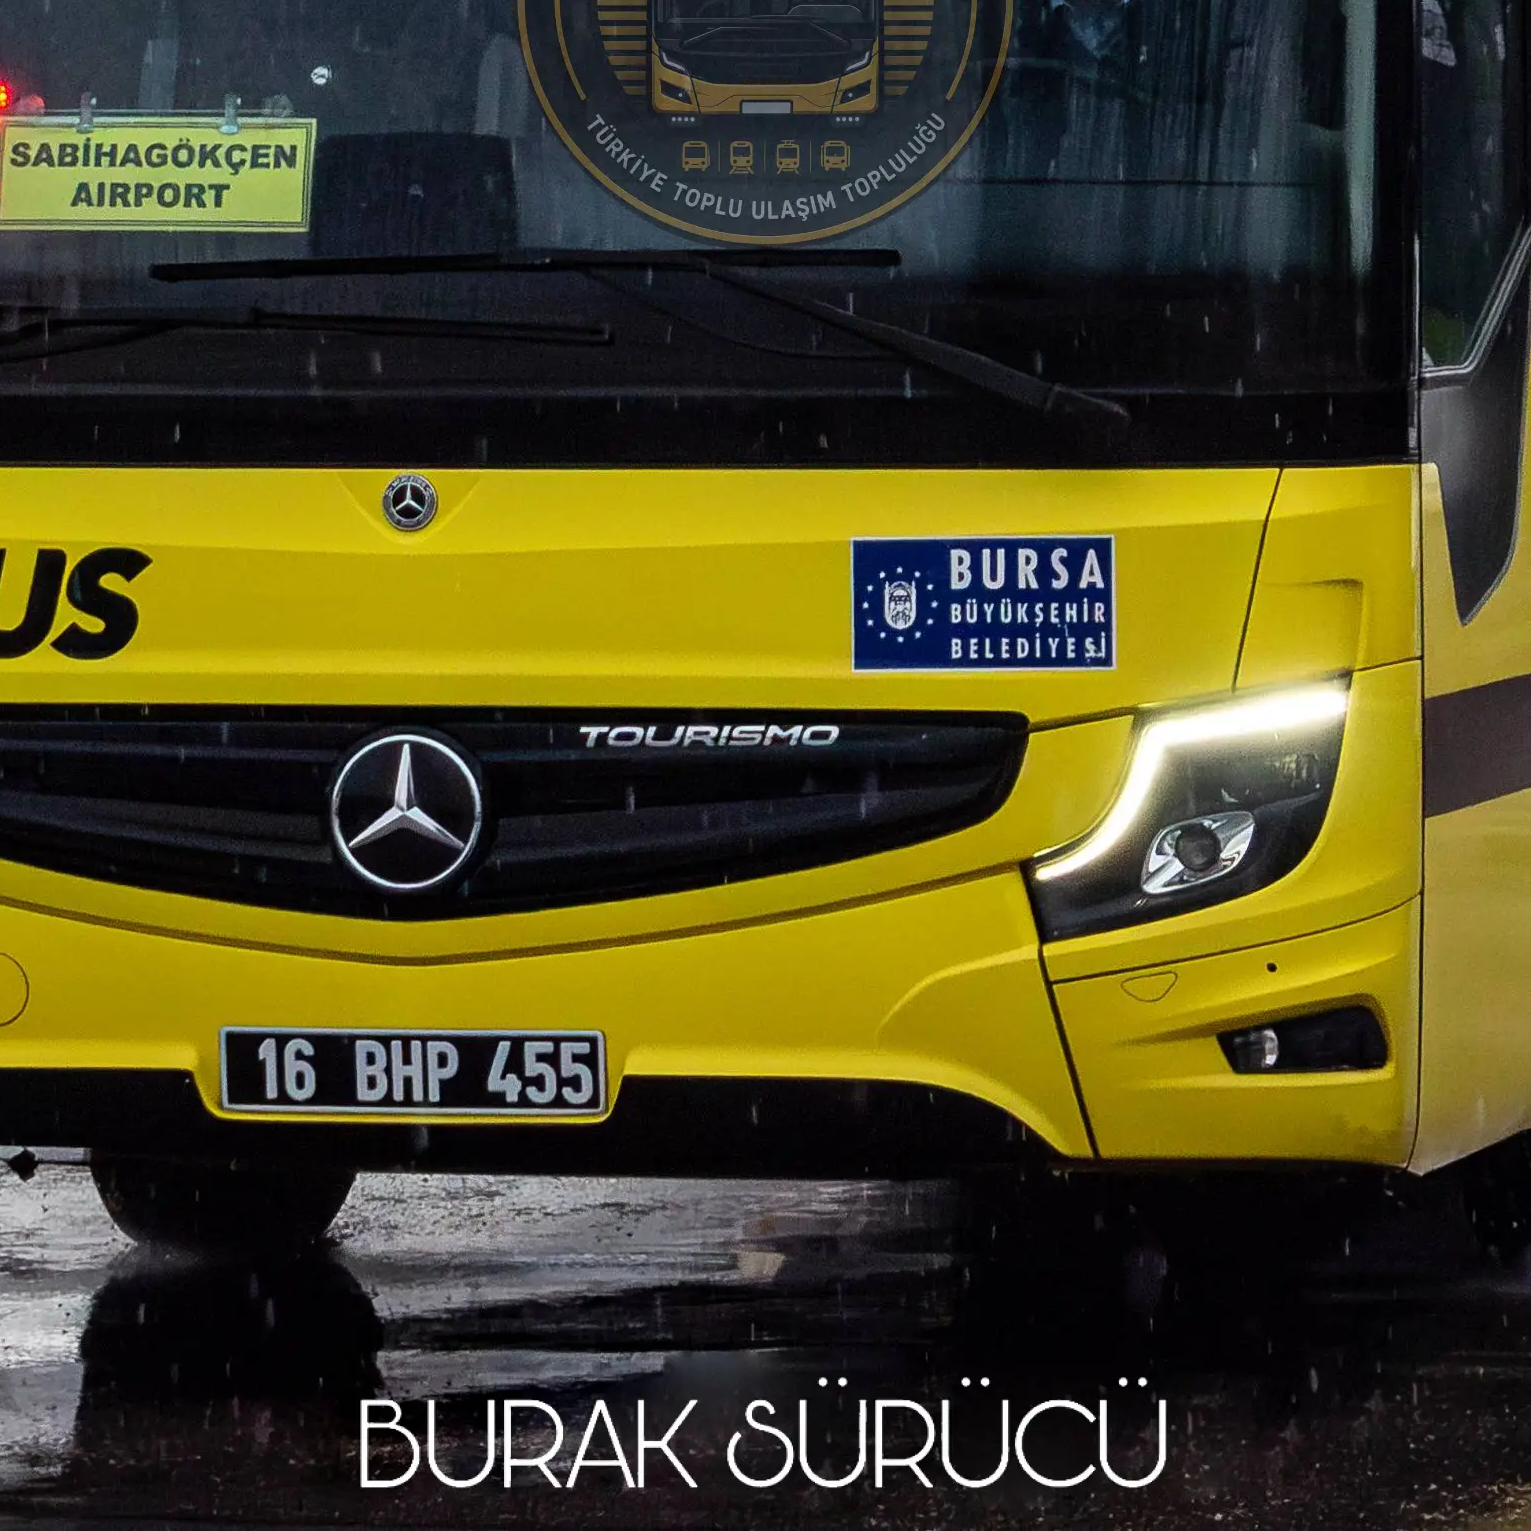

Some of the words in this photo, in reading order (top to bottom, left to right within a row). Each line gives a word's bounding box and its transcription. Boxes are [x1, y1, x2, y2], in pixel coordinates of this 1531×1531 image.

[9, 136, 298, 176] SABİHAGÖKÇEN
[70, 182, 230, 209] AIRPORT
[950, 548, 1106, 590] BURSA
[950, 598, 1106, 627] BÜYÜKŞEHİR
[950, 632, 1107, 659] BELEDİYESİ
[579, 724, 840, 748] TOURISMO
[258, 1037, 316, 1102] 16
[354, 1039, 459, 1103] BHP
[487, 1040, 594, 1105] 455
